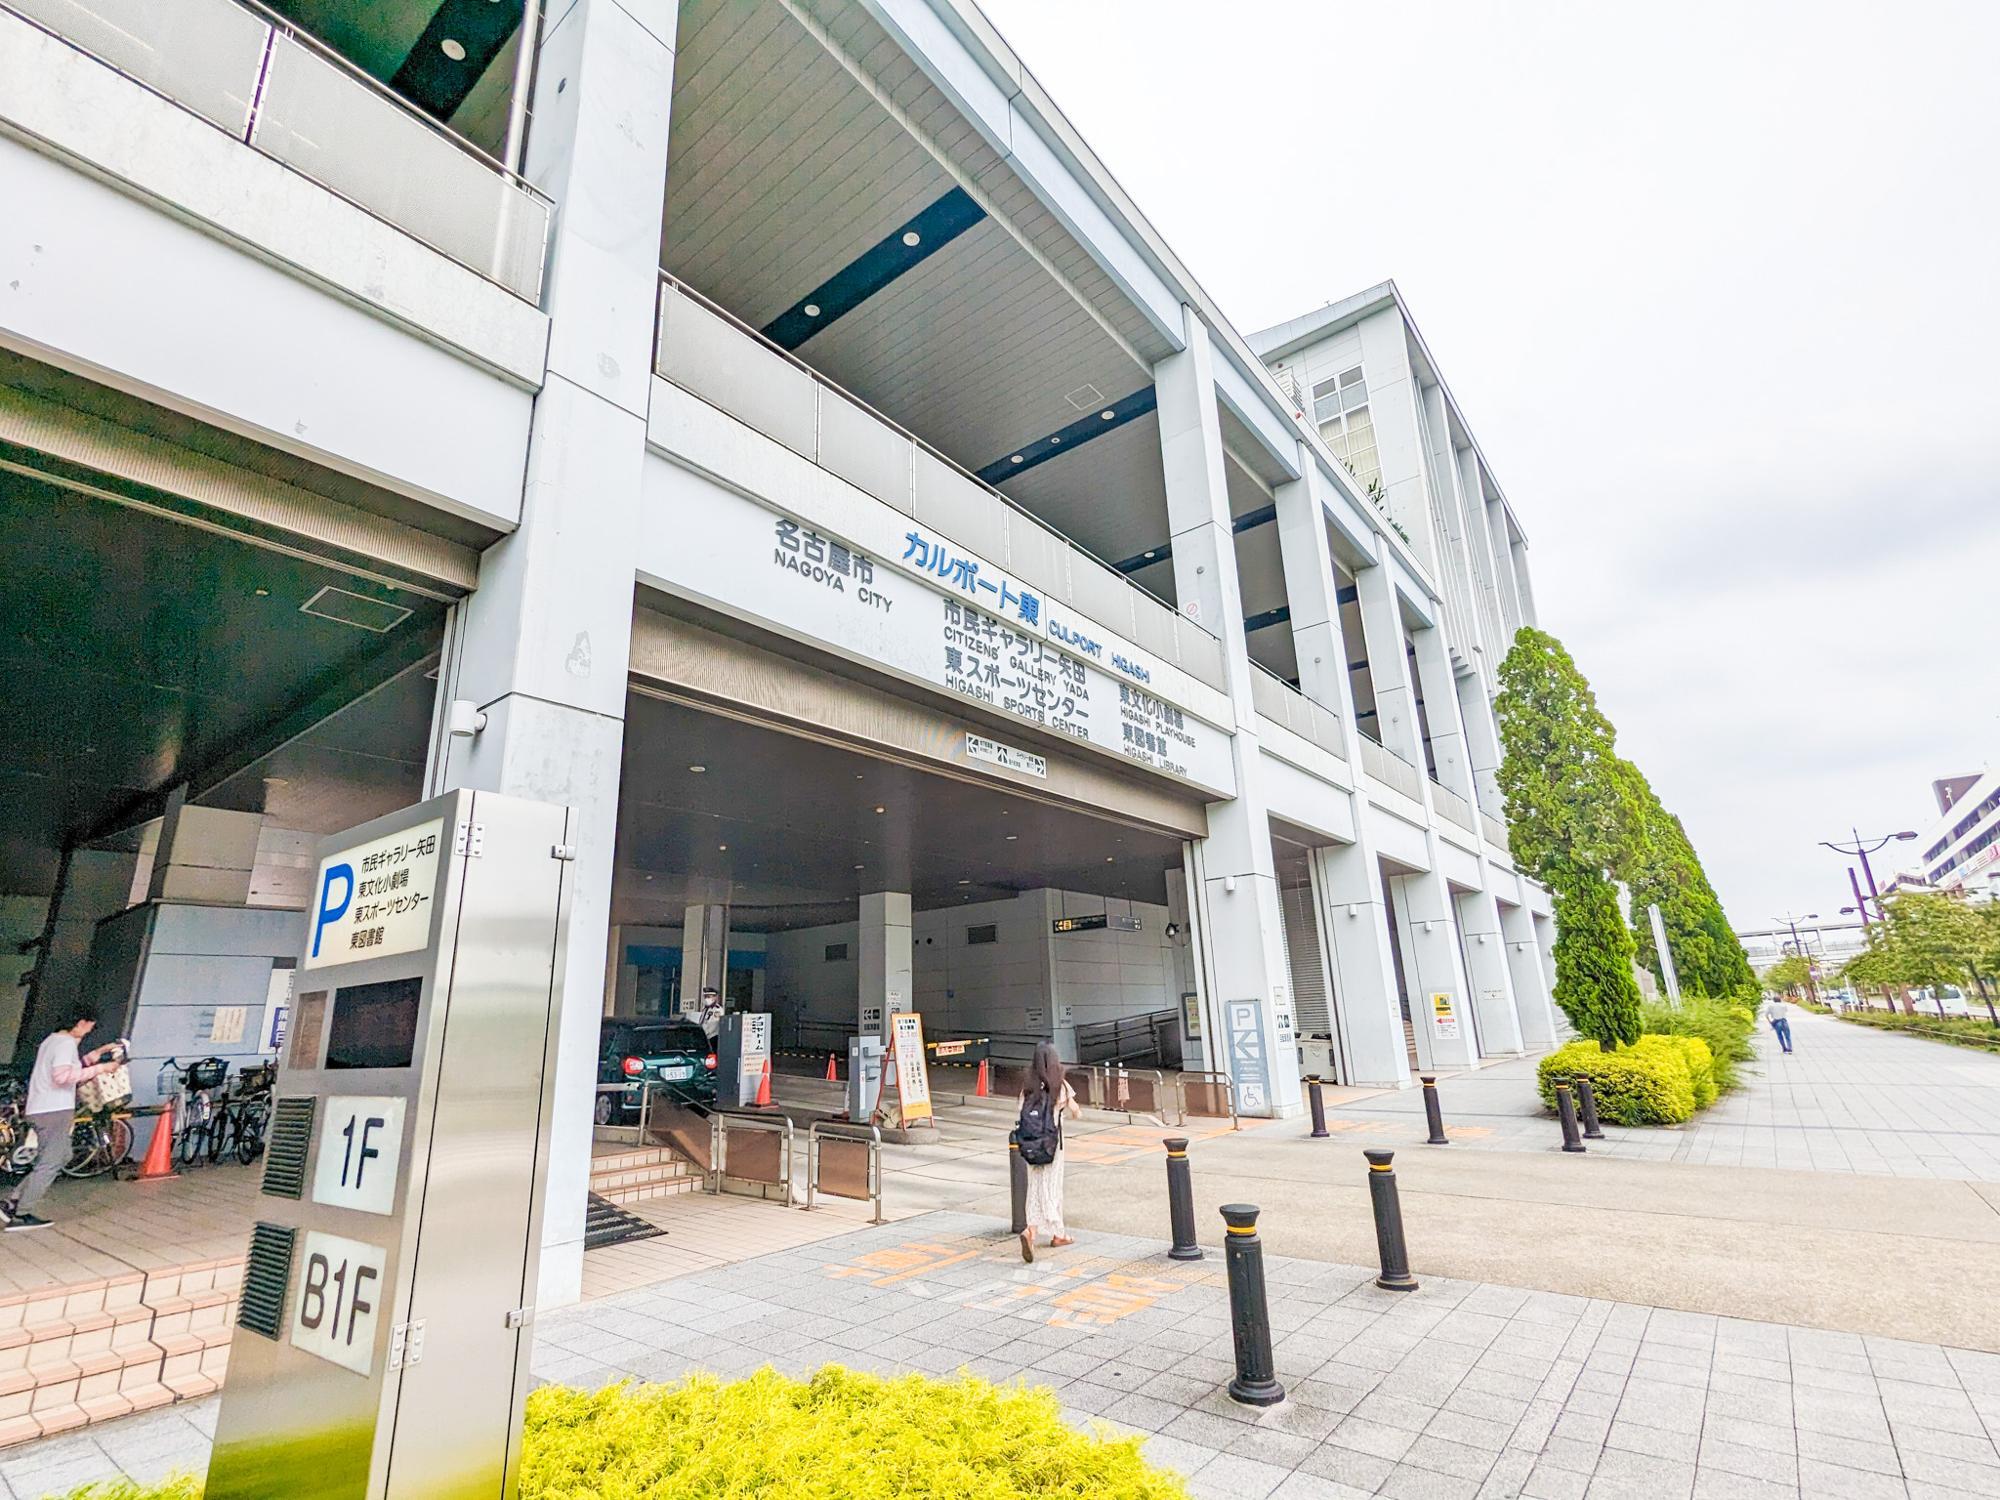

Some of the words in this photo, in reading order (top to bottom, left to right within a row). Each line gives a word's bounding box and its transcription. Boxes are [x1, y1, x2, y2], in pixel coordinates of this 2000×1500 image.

[774, 518, 874, 585] 名古屋市
[903, 531, 1040, 627] カルポート東
[774, 548, 845, 593] NAGOYA
[858, 587, 893, 613] CITY
[943, 598, 1086, 685] 市民ギャラリー矢田
[1048, 619, 1104, 659] CULPORT
[1111, 651, 1151, 684] HIGASHI
[944, 645, 1089, 718] 東スポーツセンター
[945, 673, 994, 704] HIGASHI
[1003, 696, 1045, 723] SPORTS
[1051, 715, 1089, 741] CENTER
[1009, 655, 1057, 686] GALLERY
[1063, 679, 1090, 702] YADA
[1119, 681, 1184, 730] 東文化小劇場
[1119, 705, 1152, 728] HIGASHI
[1155, 721, 1196, 748] PLAYHOUSE
[1121, 722, 1168, 757] 東図書館
[1123, 743, 1154, 764] HIGASHI
[1158, 757, 1188, 777] LIBRARY
[361, 834, 436, 874] 市民ギャラリー矢田
[311, 863, 355, 958] P
[353, 892, 429, 924] 東スポーツセンター
[357, 868, 410, 899] 東文化小劇場
[349, 926, 385, 950] 東図書館
[1236, 1008, 1251, 1027] P
[342, 1114, 385, 1189] 1F
[301, 1252, 378, 1346] B1F
